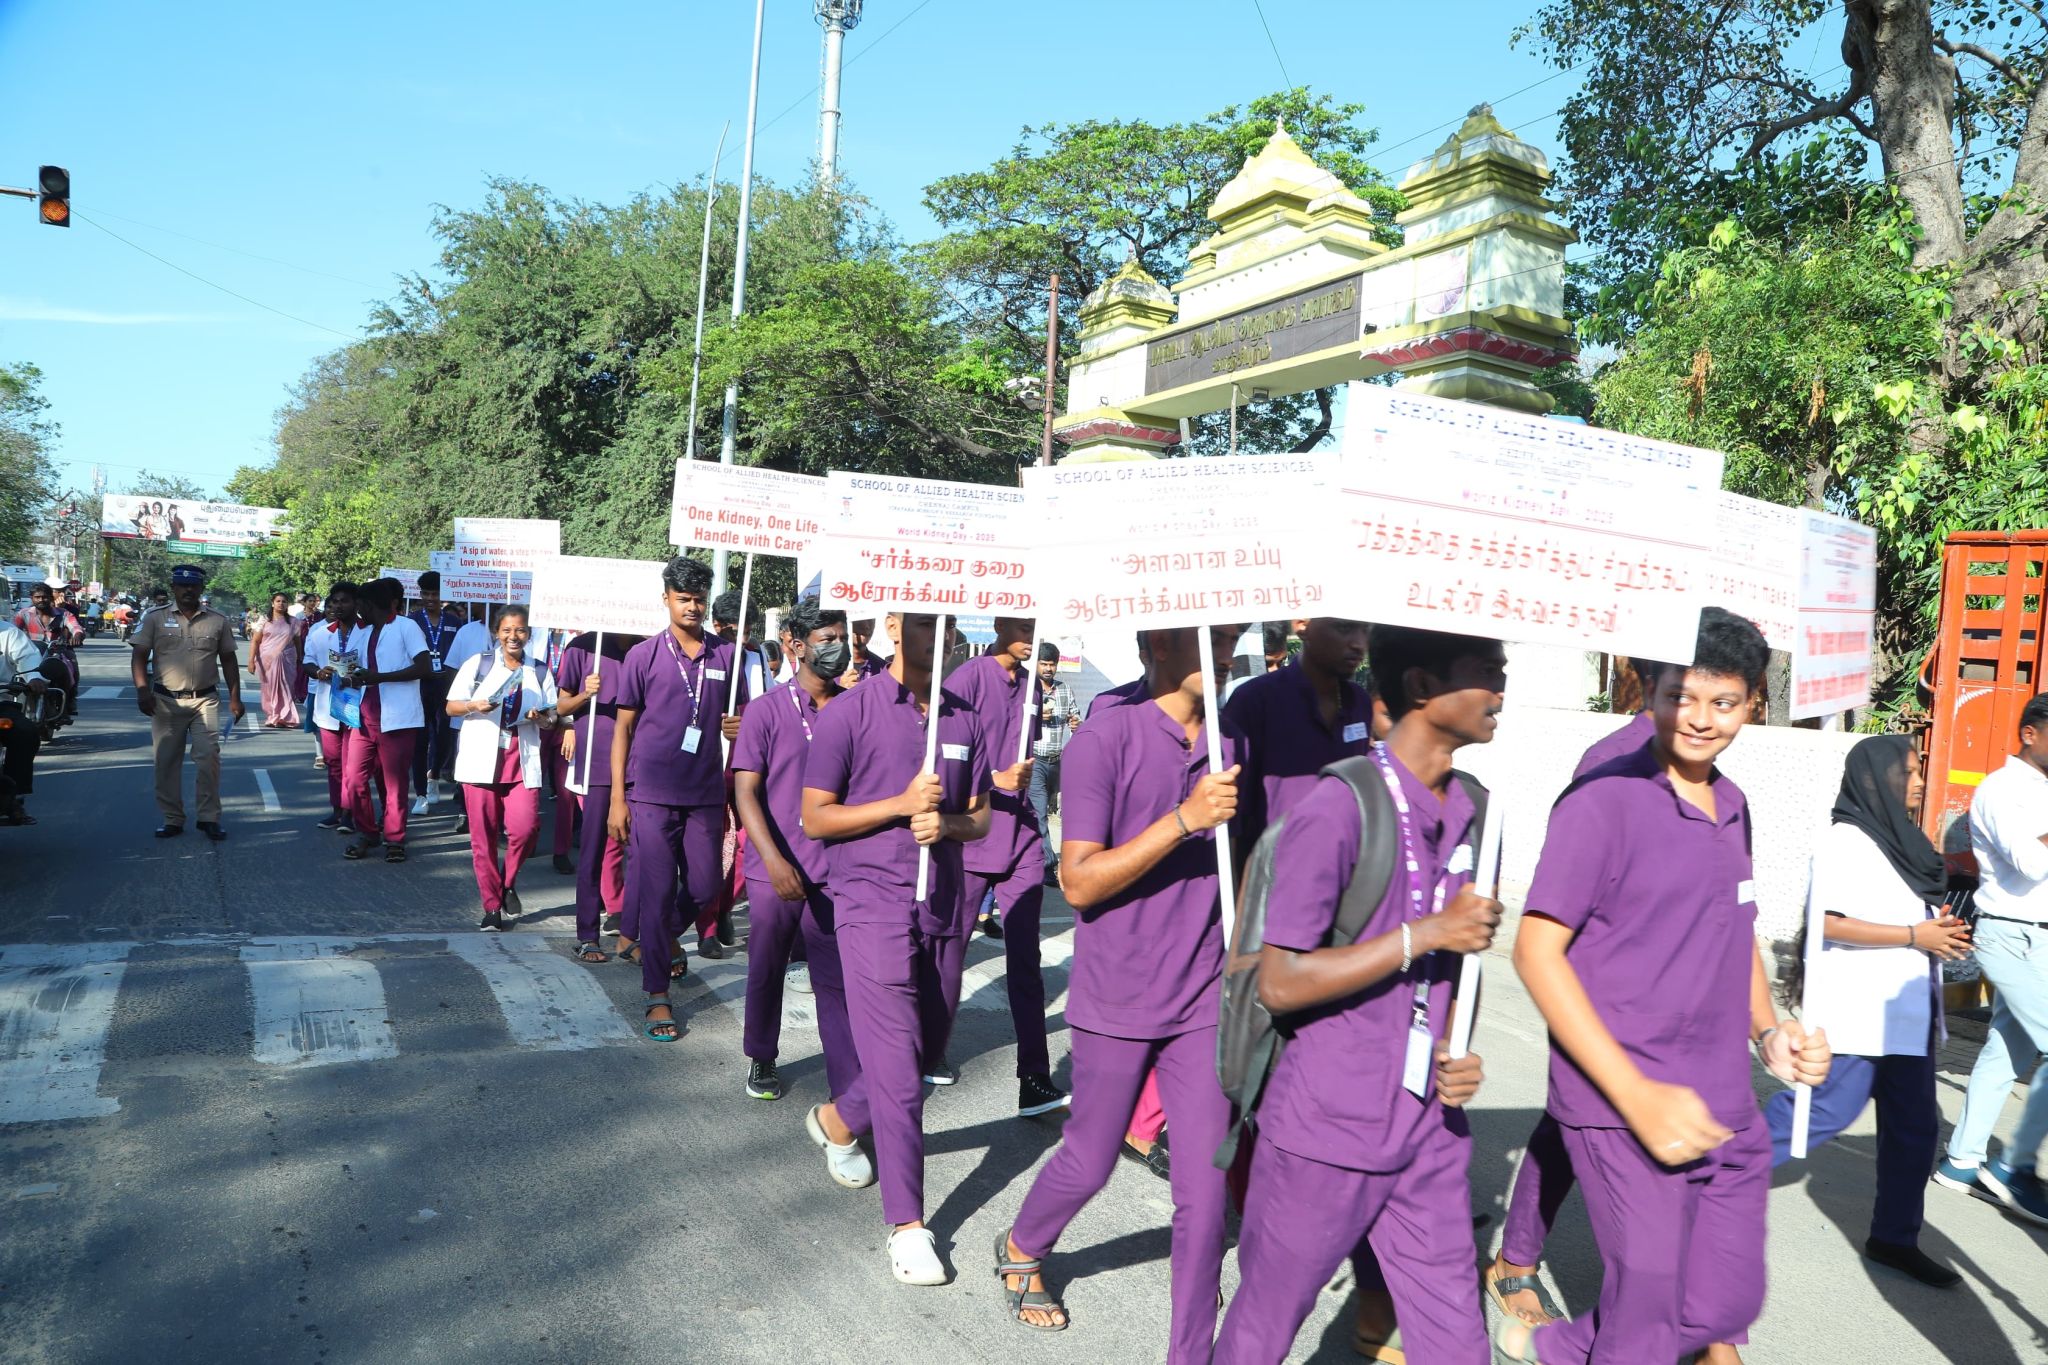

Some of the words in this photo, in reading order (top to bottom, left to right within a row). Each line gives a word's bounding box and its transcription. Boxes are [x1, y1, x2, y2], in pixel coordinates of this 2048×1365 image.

[692, 463, 722, 473] SCHOOL
[724, 467, 734, 475] OF
[735, 469, 761, 479] ALLIED
[763, 472, 790, 483] HEALTH
[792, 476, 826, 487] SCIENCES
[1054, 470, 1111, 484] SCHOOL
[1116, 468, 1135, 480] OF
[1140, 465, 1189, 479] ALLIED
[1194, 463, 1246, 476] HEALTH
[1250, 460, 1315, 475] SCIENCES
[851, 478, 893, 493] SCHOOL
[897, 483, 910, 493] OF
[913, 485, 950, 497] ALLIED
[954, 488, 994, 501] HEALTH
[680, 505, 713, 521] “One
[718, 509, 763, 529] Kidney,
[768, 515, 791, 531] One
[796, 519, 819, 534] Life
[694, 527, 739, 544] Handle
[744, 533, 770, 548] with
[775, 535, 811, 551] Care”
[897, 527, 920, 536] World
[924, 529, 950, 540] Kidney
[953, 531, 967, 541] Day
[460, 558, 475, 567] Love
[476, 559, 490, 569] your
[469, 547, 479, 557] sip
[480, 547, 487, 555] of
[861, 547, 965, 575] “சர்க்கரை
[970, 559, 1025, 580] குறை
[1234, 541, 1282, 570] உப்பு
[830, 580, 968, 604] ஆரோக்கியம்
[1063, 586, 1245, 623] ஆரோக்கியமான
